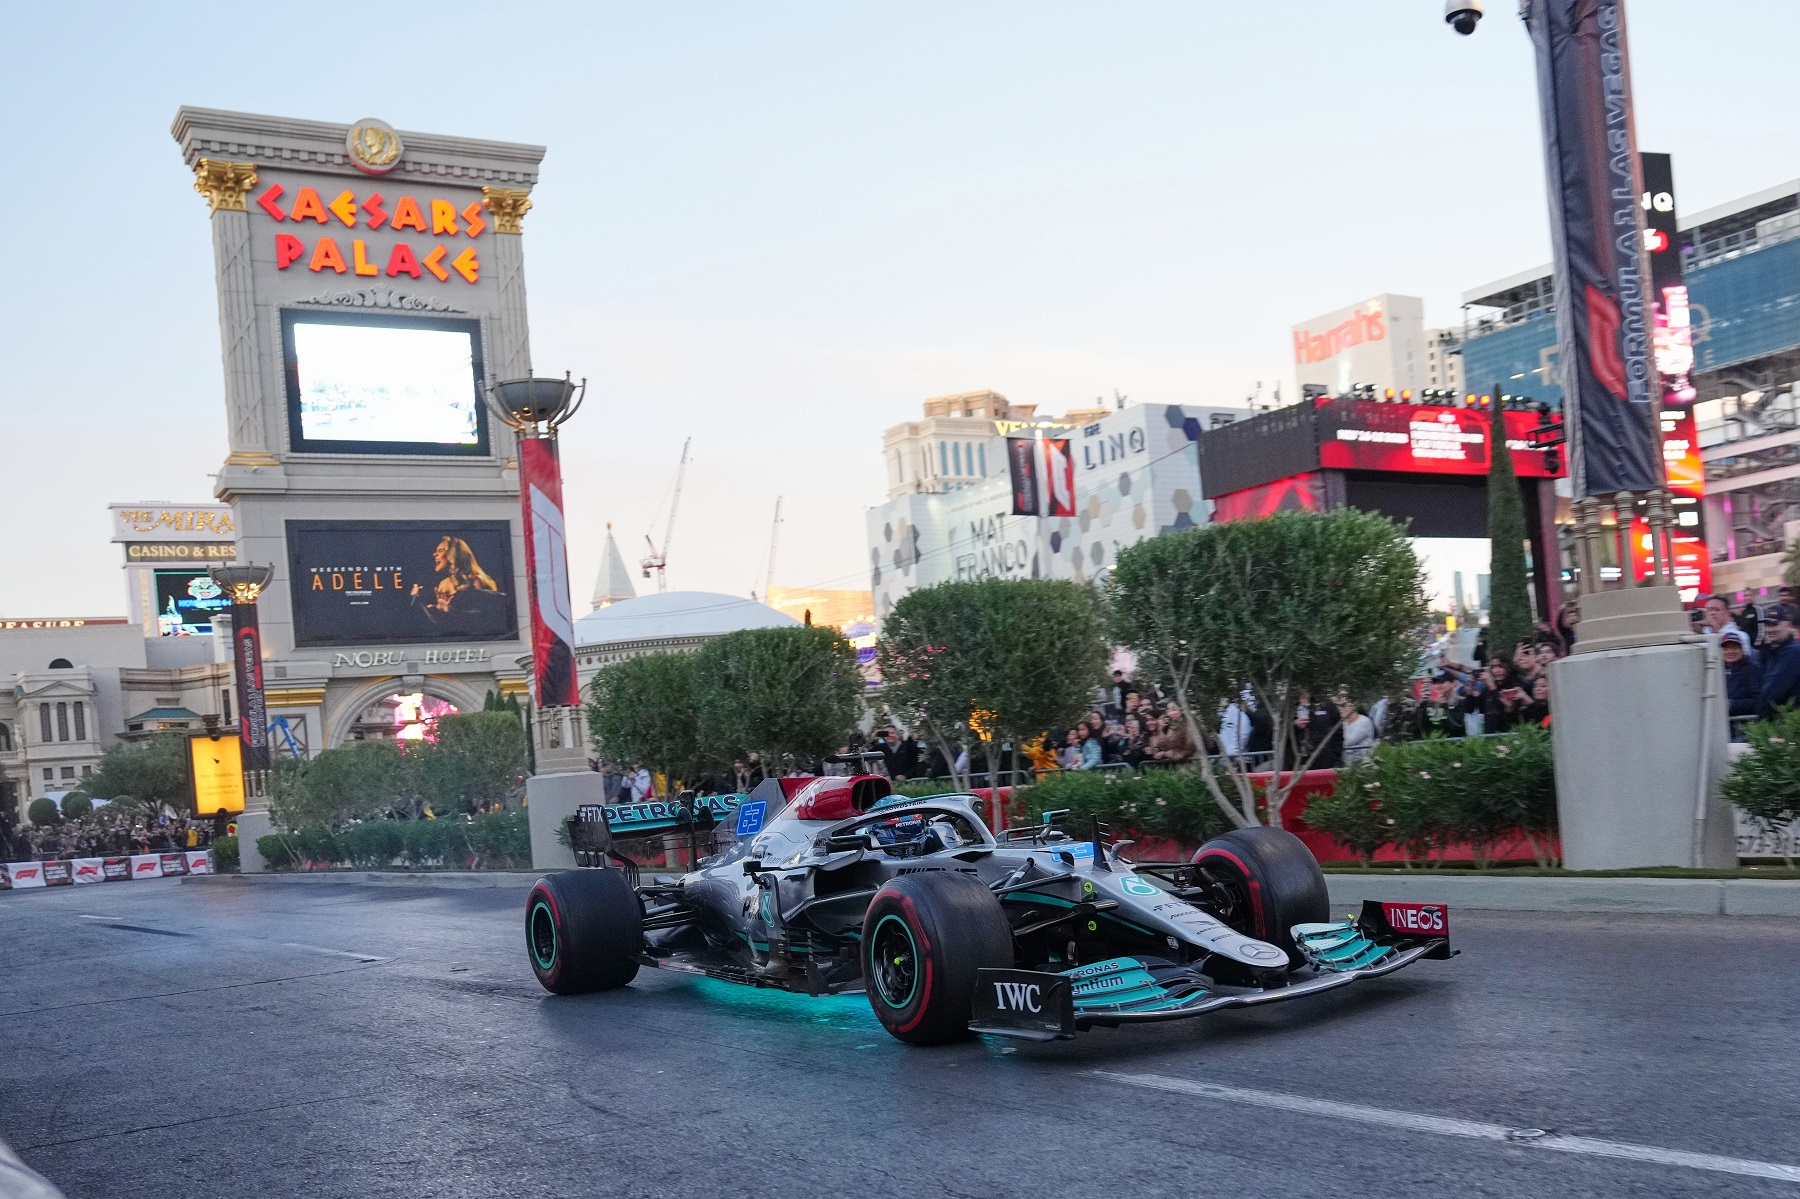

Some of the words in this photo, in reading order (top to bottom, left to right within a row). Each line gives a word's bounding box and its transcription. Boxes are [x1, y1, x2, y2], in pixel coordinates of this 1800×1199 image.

[1597, 5, 1628, 125] VEGAS
[1607, 130, 1636, 199] LAS
[257, 183, 487, 238] CAESARS
[276, 234, 481, 284] PALACE
[1615, 231, 1652, 403] FORMULA
[1084, 426, 1145, 469] LINQ
[121, 510, 154, 523] THE
[970, 512, 1006, 549] MAT
[128, 544, 189, 557] CASINO
[192, 546, 204, 557] &
[956, 539, 1028, 582] FRANCO
[312, 573, 403, 591] ADELE
[334, 651, 404, 668] NOBU
[425, 649, 489, 664] HOTEL
[587, 807, 604, 822] FTX
[737, 801, 766, 835] 63
[1391, 907, 1443, 930] INEOS
[1071, 975, 1124, 995] yntium
[1077, 962, 1119, 976] RONAS
[993, 982, 1042, 1013] IWC
